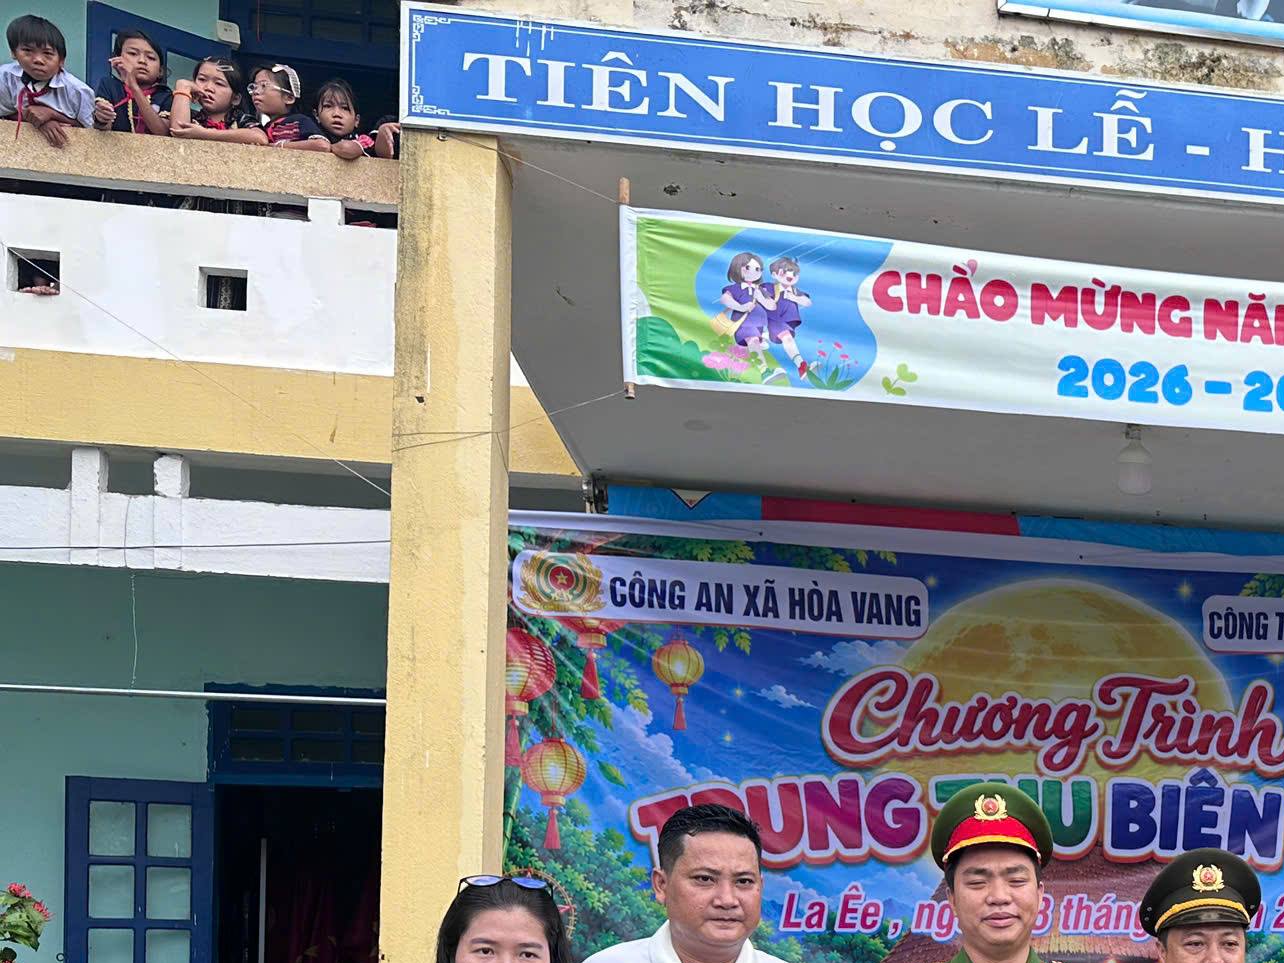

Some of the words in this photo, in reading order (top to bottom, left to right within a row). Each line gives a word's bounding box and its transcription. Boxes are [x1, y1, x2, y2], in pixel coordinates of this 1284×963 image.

[463, 51, 735, 122] TIÊN
[767, 82, 994, 152] HỌC
[1027, 89, 1156, 161] LỄ
[872, 264, 1019, 321] CHÀO
[1030, 278, 1192, 337] MỪNG
[1057, 355, 1193, 405] 2026
[609, 571, 686, 610] CÔNG
[695, 581, 733, 615] AN
[743, 579, 780, 619] XÃ
[788, 580, 844, 623] HÒA
[850, 591, 922, 627] VANG
[1208, 606, 1269, 641] CÔNG
[828, 670, 1099, 771] Chương
[1111, 768, 1282, 859] BIÊN
[782, 893, 826, 929] La
